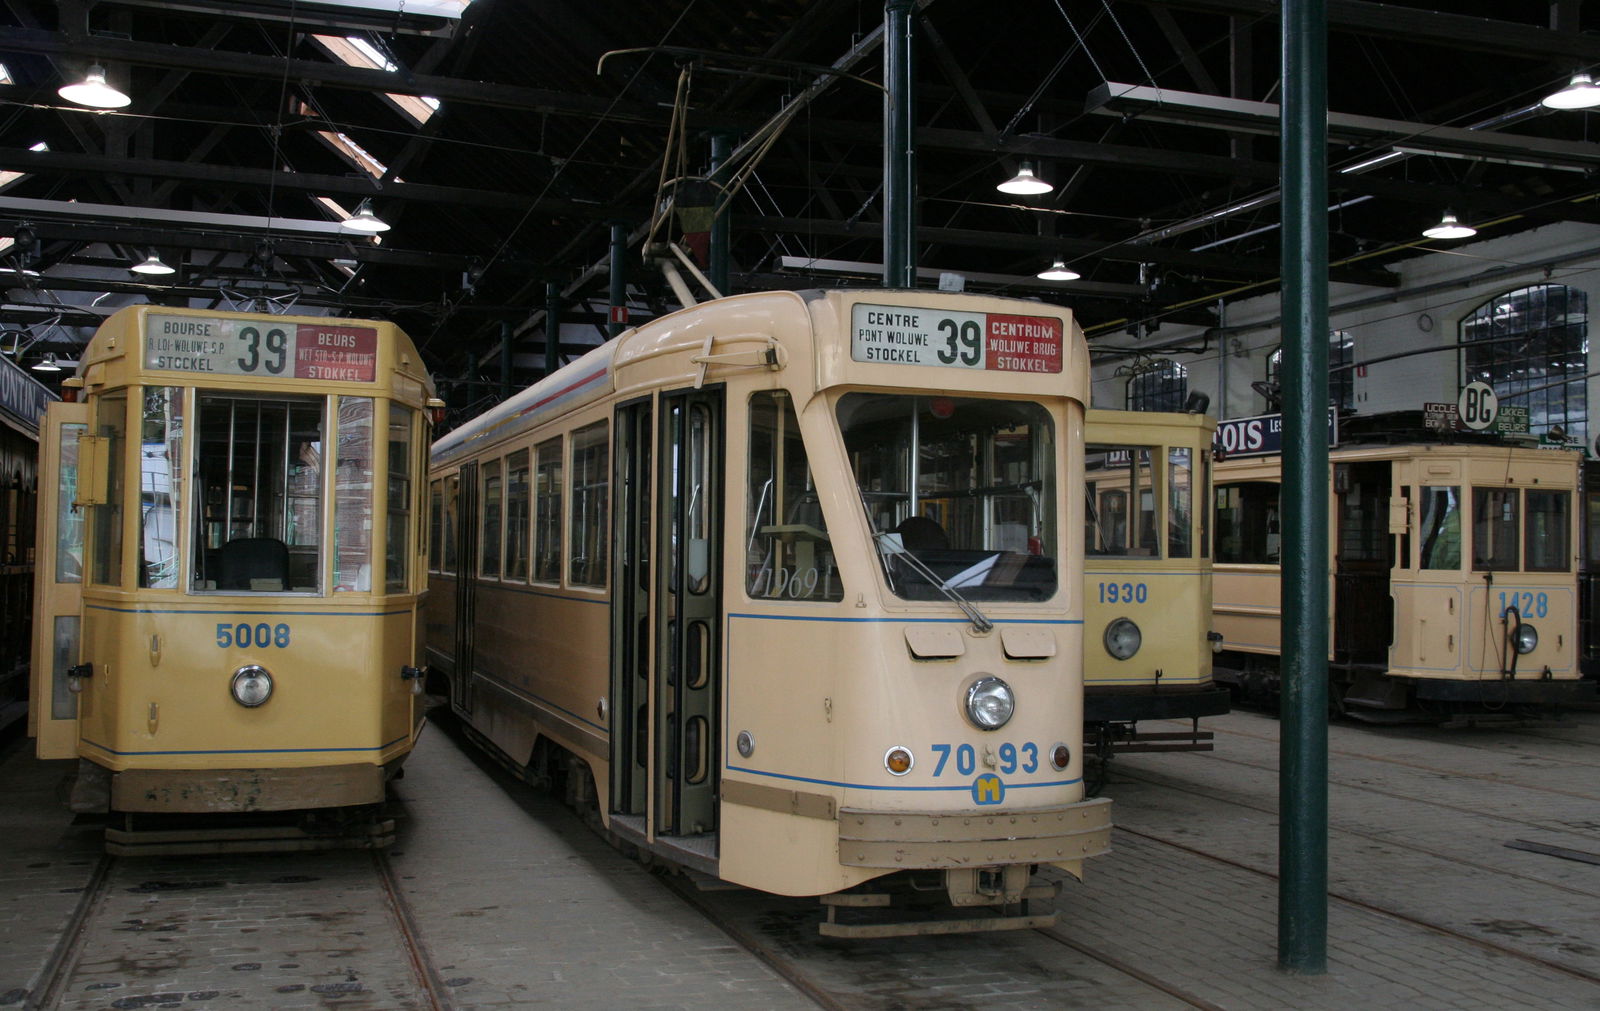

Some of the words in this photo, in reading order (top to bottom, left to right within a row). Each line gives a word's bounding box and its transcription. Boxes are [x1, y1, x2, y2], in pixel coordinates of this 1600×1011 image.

[868, 312, 919, 328] CENTRE
[164, 321, 211, 337] BOURSE
[991, 322, 1053, 339] CENTRUM
[318, 333, 356, 348] BEURS
[859, 329, 882, 343] PONT
[886, 331, 929, 347] WOLUWE
[937, 318, 981, 366] 39
[238, 326, 287, 374] 39
[867, 347, 921, 363] STOCKEL
[990, 338, 1030, 354] WOLUWE
[1033, 342, 1056, 356] BRUG
[158, 355, 214, 371] STOCKEL
[997, 357, 1049, 372] STOKKEL
[309, 366, 362, 381] STOKKEL
[1426, 403, 1457, 414] UCCLE
[1466, 387, 1492, 424] BG
[1500, 408, 1528, 417] UKKEL
[1498, 422, 1527, 432] BEURS
[761, 567, 818, 598] 1969
[1099, 582, 1147, 604] 1930
[1498, 591, 1548, 618] 1428
[216, 623, 290, 649] 5008
